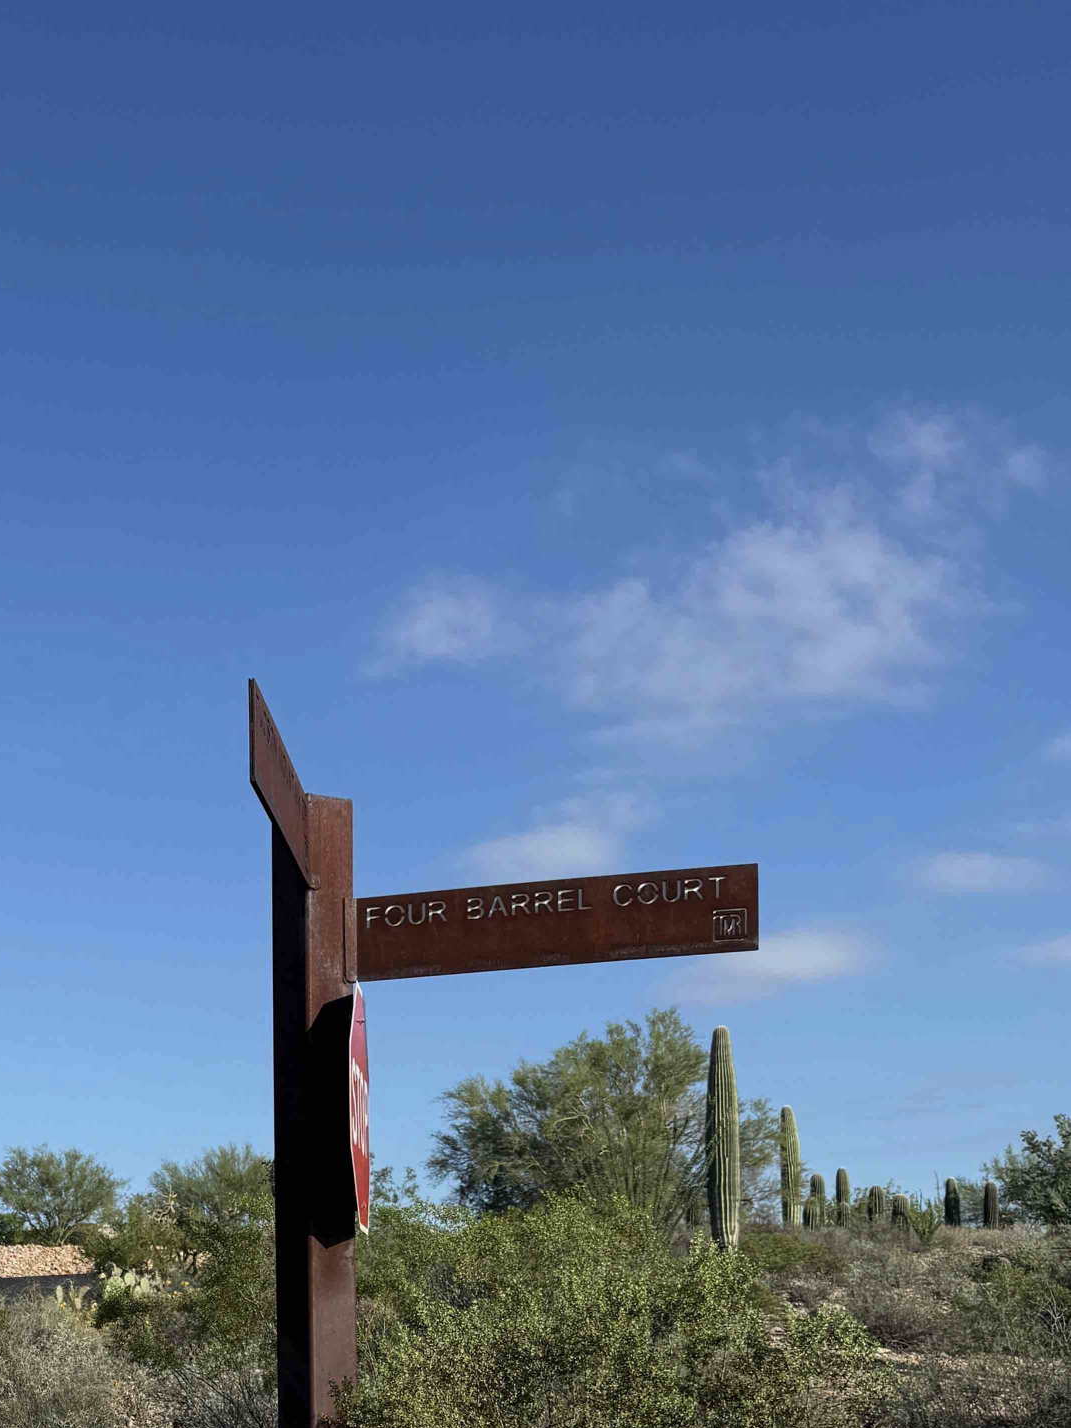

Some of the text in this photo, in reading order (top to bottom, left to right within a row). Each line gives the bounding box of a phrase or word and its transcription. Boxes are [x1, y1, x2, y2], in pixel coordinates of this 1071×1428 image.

[366, 876, 726, 929] FOUR BARREL COURT
[351, 1057, 369, 1158] STOP
